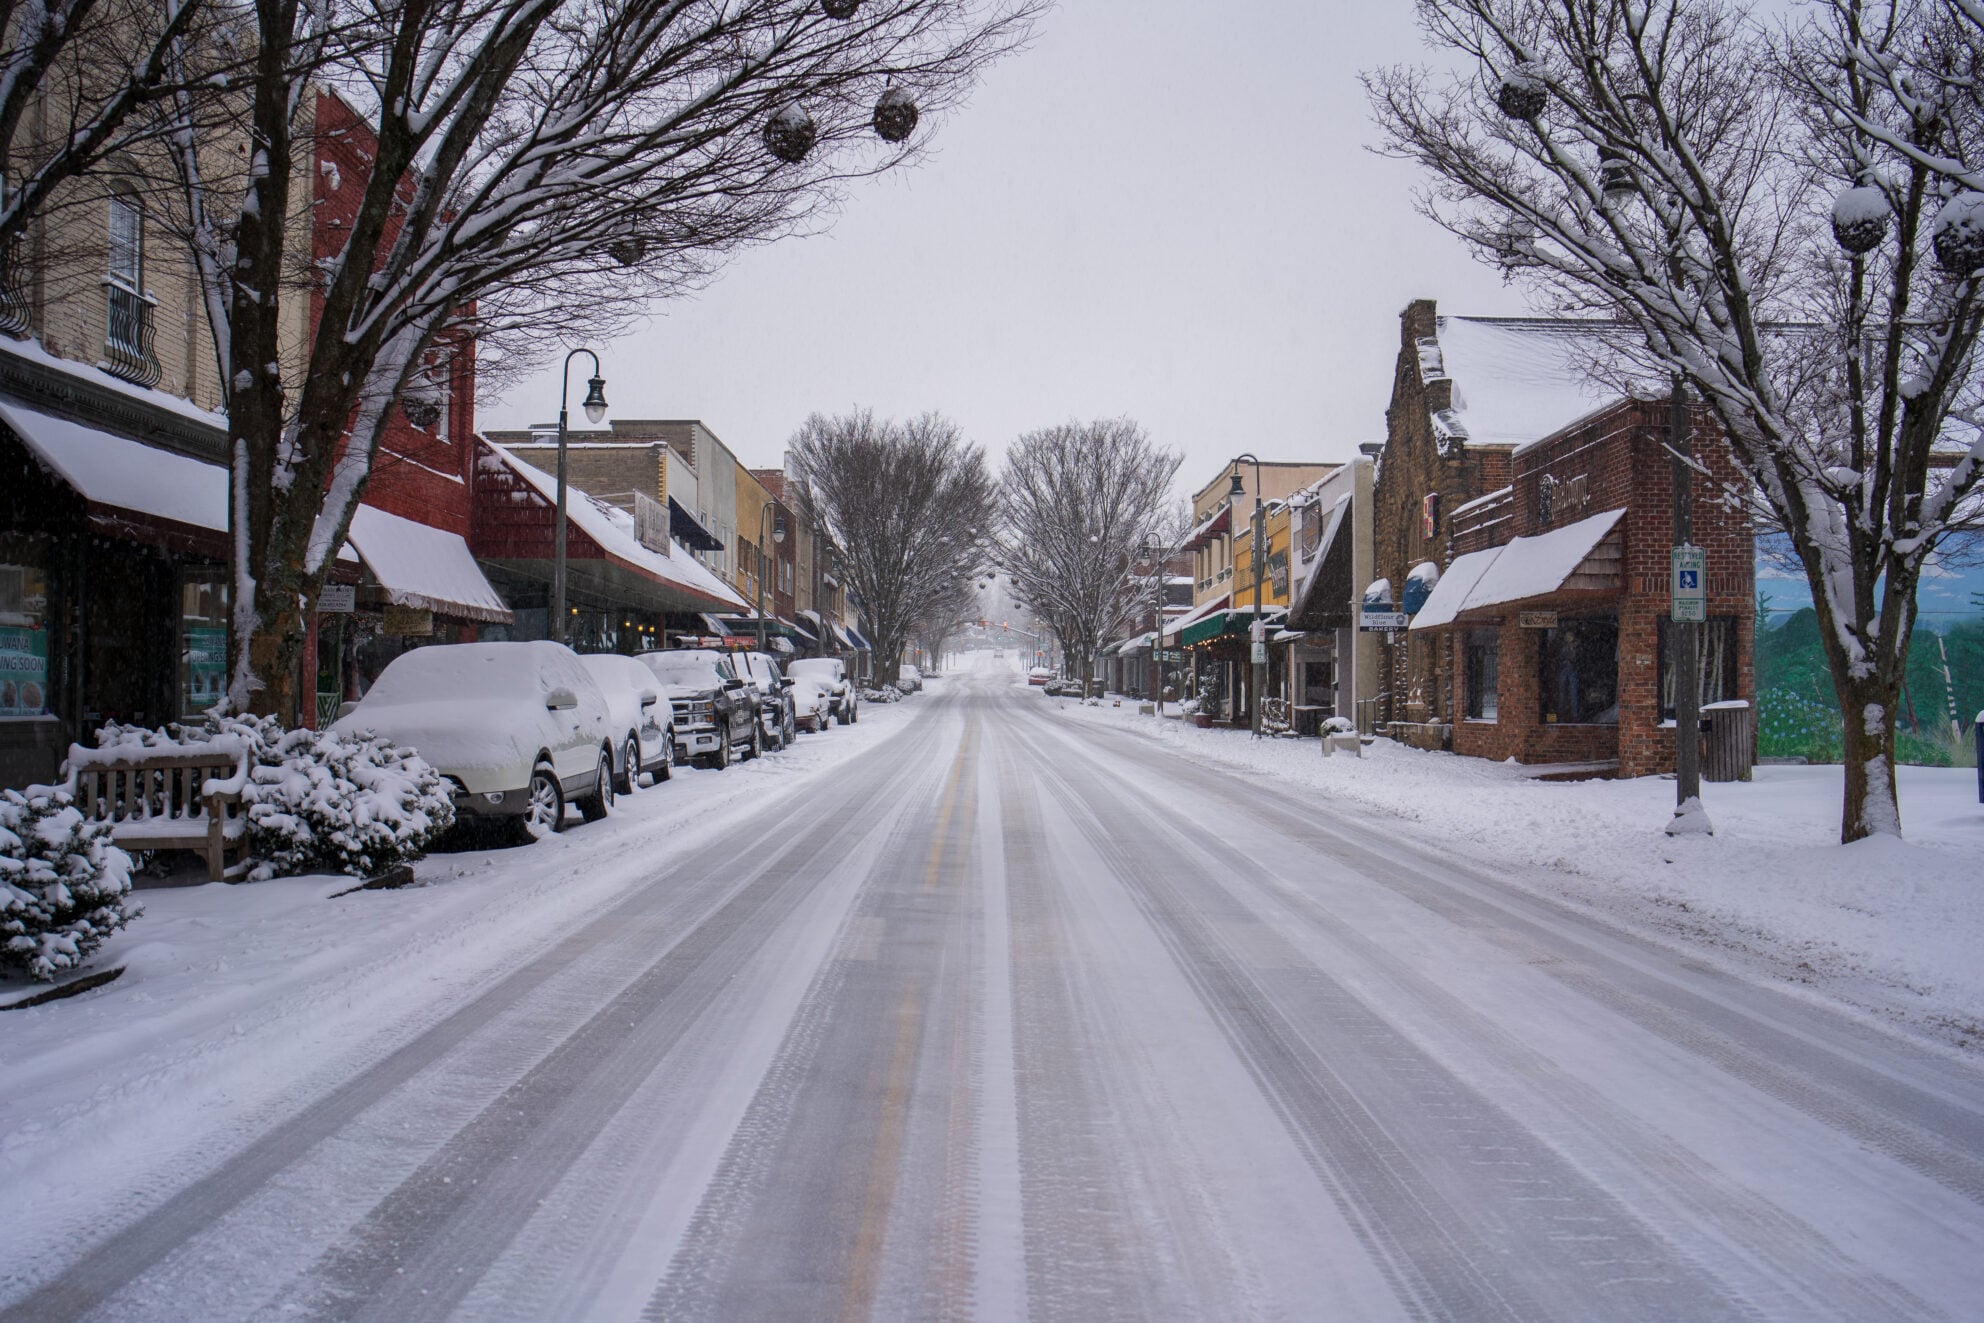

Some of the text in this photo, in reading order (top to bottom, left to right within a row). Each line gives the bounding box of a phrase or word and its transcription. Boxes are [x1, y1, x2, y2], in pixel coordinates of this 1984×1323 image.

[1673, 552, 1703, 560] RESVED
[1678, 561, 1701, 569] AING
[19, 657, 44, 672] SOON
